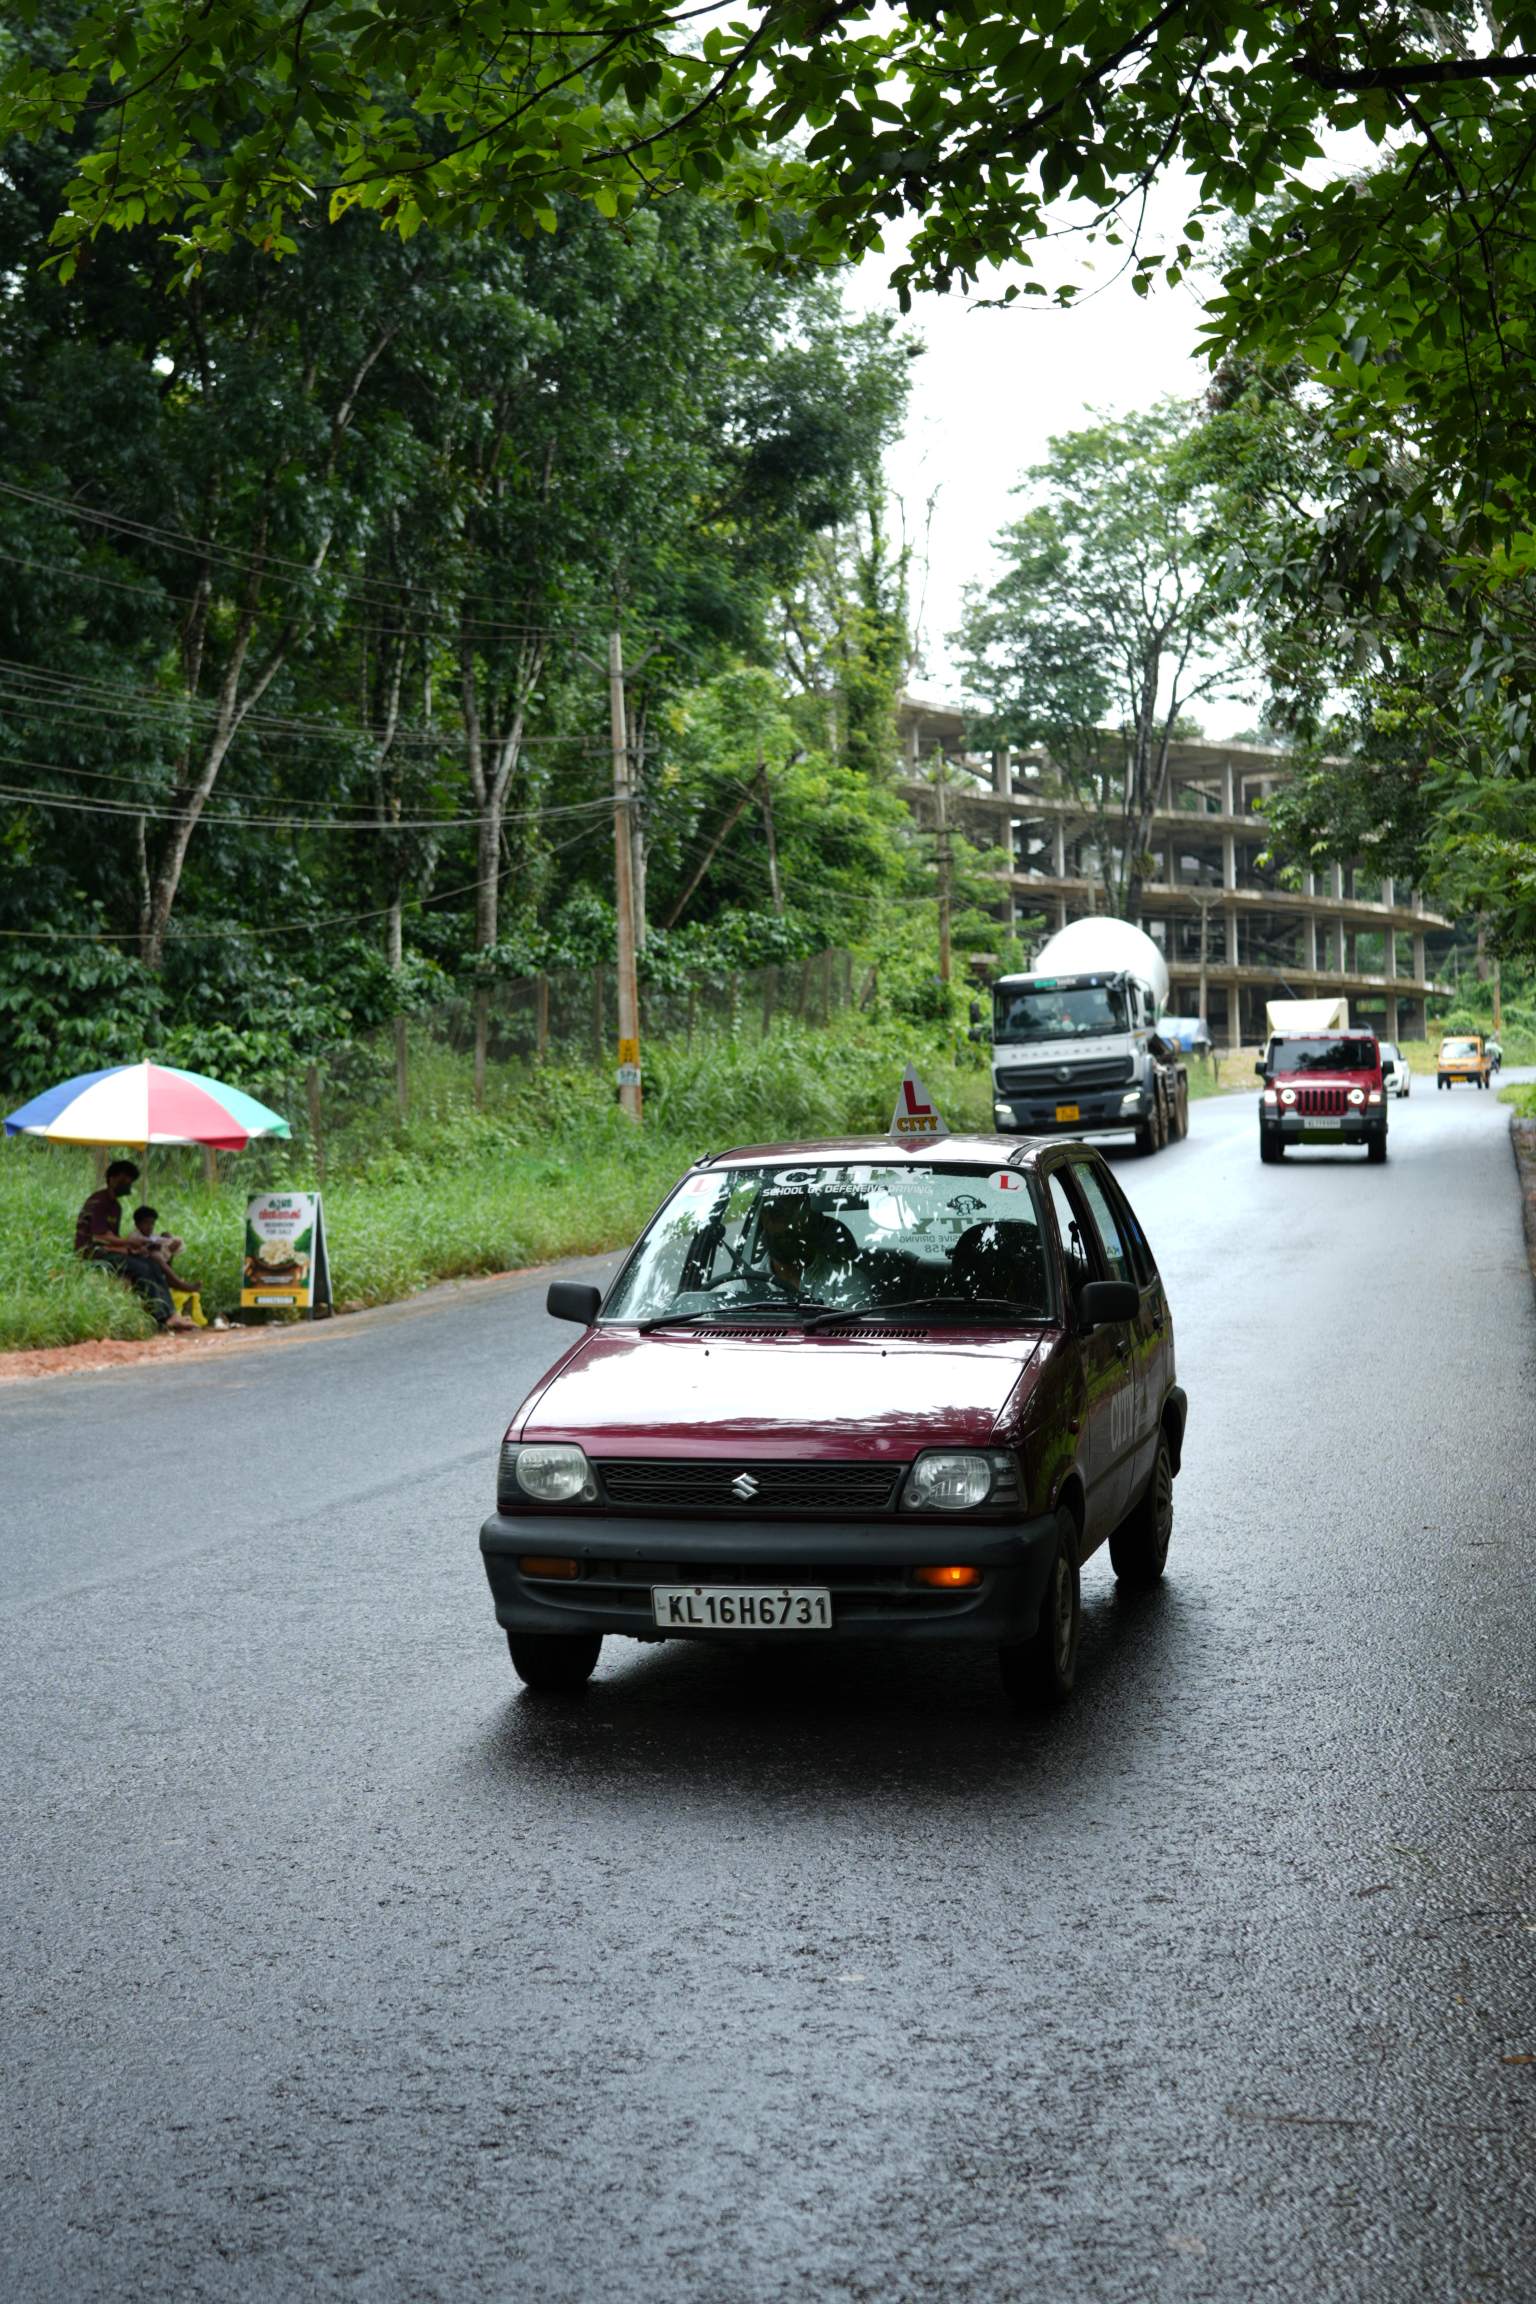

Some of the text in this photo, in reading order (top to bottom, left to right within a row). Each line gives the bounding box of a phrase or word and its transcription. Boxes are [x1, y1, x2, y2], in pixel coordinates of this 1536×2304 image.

[903, 1081, 931, 1114] L
[897, 1116, 937, 1132] CITY
[773, 1166, 932, 1186] CITY
[1000, 1175, 1019, 1189] L
[762, 1186, 804, 1197] SCHOOL
[669, 1595, 827, 1625] KL16H6731
